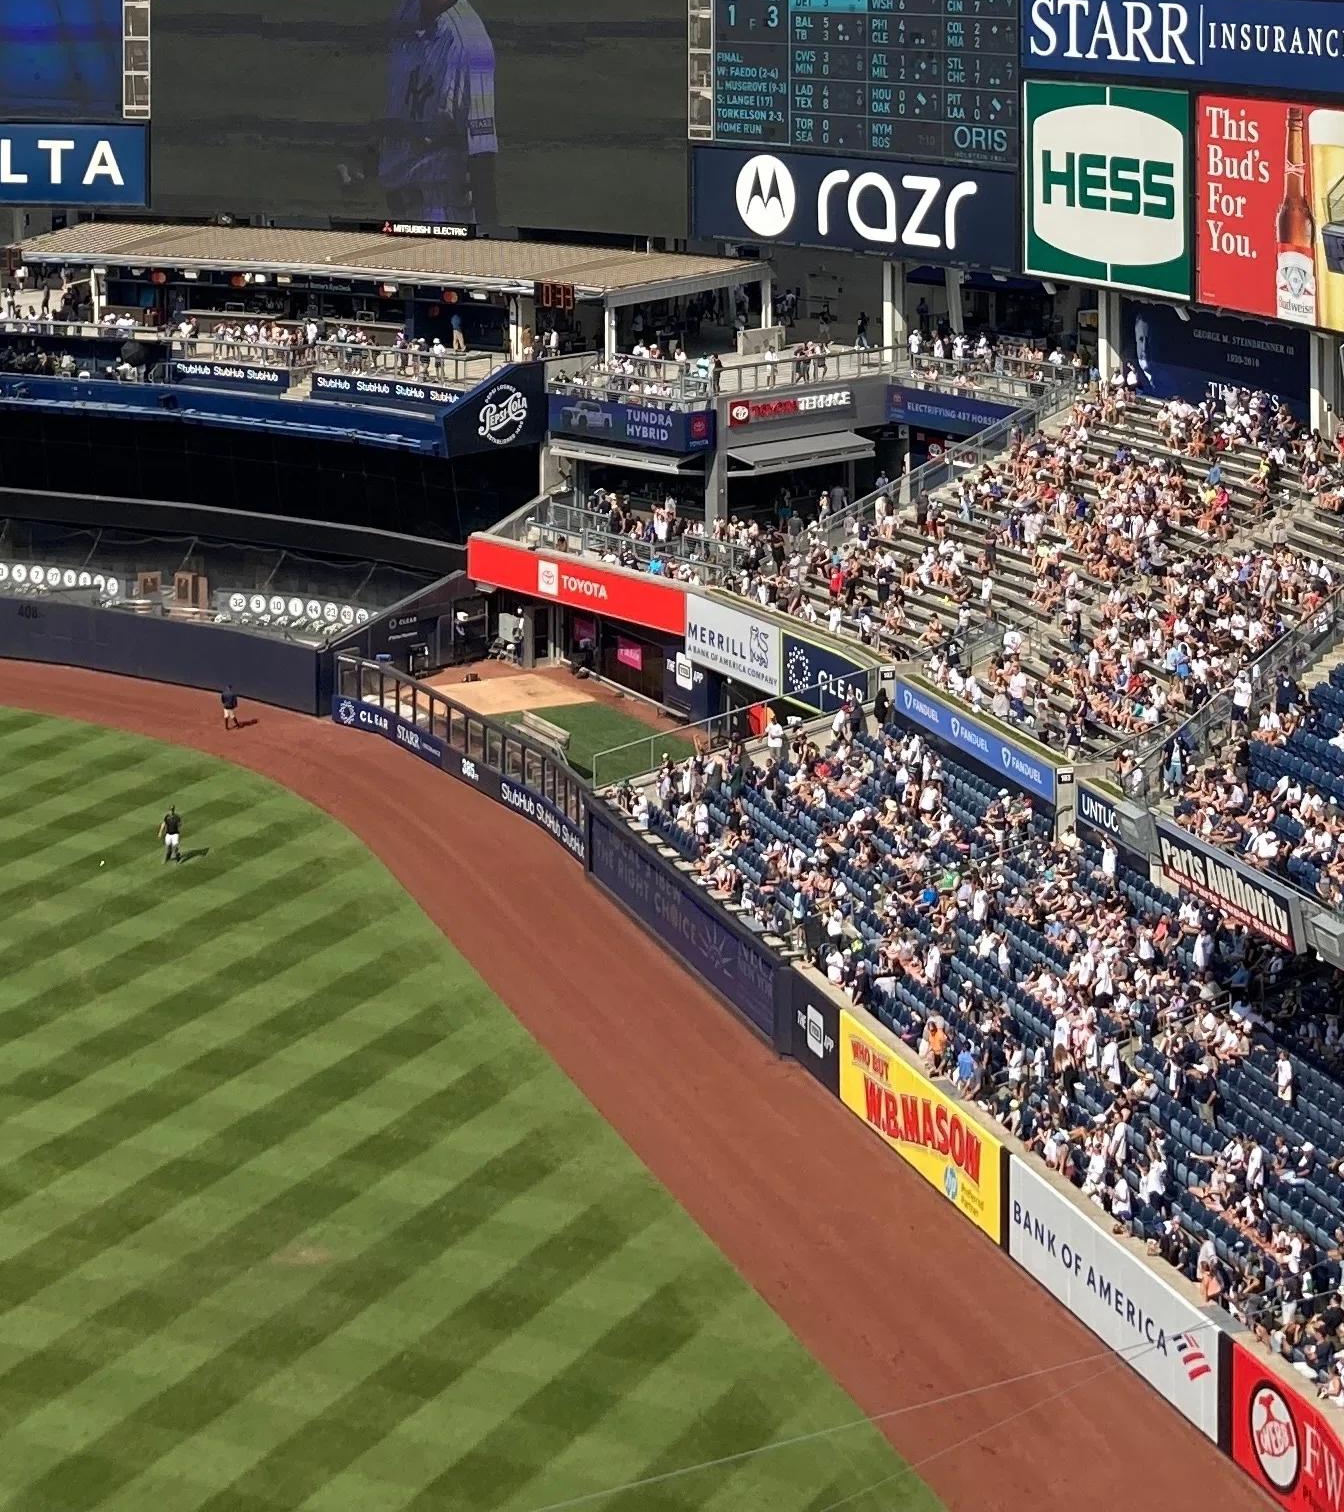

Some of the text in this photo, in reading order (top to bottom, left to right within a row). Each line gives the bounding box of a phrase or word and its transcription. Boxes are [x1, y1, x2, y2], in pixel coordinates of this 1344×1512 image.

[947, 0, 963, 12] CIN
[767, 5, 778, 28] 3
[795, 16, 813, 28] BAL
[872, 32, 888, 43] CLE
[947, 22, 964, 34] COL
[795, 51, 816, 62] CWS
[872, 54, 888, 65] ATL
[947, 58, 964, 70] STL
[724, 81, 768, 93] MUSGROVE
[947, 72, 966, 83] CHC
[795, 84, 813, 96] LAD
[872, 89, 891, 100] HOU
[795, 97, 813, 109] TEX
[872, 102, 890, 114] OAK
[716, 108, 767, 121] TORKELSON
[947, 107, 965, 119] LAA
[716, 122, 762, 135] HOME RUN
[795, 118, 813, 130] TOR
[1206, 105, 1259, 143] This
[795, 131, 813, 143] SEA
[872, 136, 890, 149] BOS
[953, 125, 1008, 152] ORIS
[1206, 143, 1270, 183] Bud's
[1041, 149, 1175, 219] HESS
[816, 169, 978, 250] razr
[1207, 182, 1247, 219] For
[1207, 220, 1257, 260] You.
[177, 363, 278, 382] StubHub StubHub StubHub
[317, 376, 351, 391] StubHub
[356, 380, 390, 394] StubHub
[395, 384, 425, 399] StubHub
[626, 409, 673, 428] TUNDRA
[907, 401, 956, 420] ELECTRIFYING
[957, 411, 970, 421] 437
[626, 424, 668, 441] HYBRID
[561, 574, 608, 600] TOYOTA
[688, 621, 747, 660] MERRILL
[695, 647, 710, 660] BANK
[711, 653, 718, 664] OF
[719, 655, 746, 675] AMERICA
[747, 666, 779, 687] COMPANY
[359, 710, 388, 730] CLEAR
[912, 698, 1043, 785] FANDUEL FANDUEL FANDUEL
[501, 782, 561, 837] StubHub StubHub
[1160, 836, 1289, 935] Parts Authority
[851, 1040, 890, 1081] WHO BUT
[1013, 1199, 1168, 1357] BANK OF AMERICA
